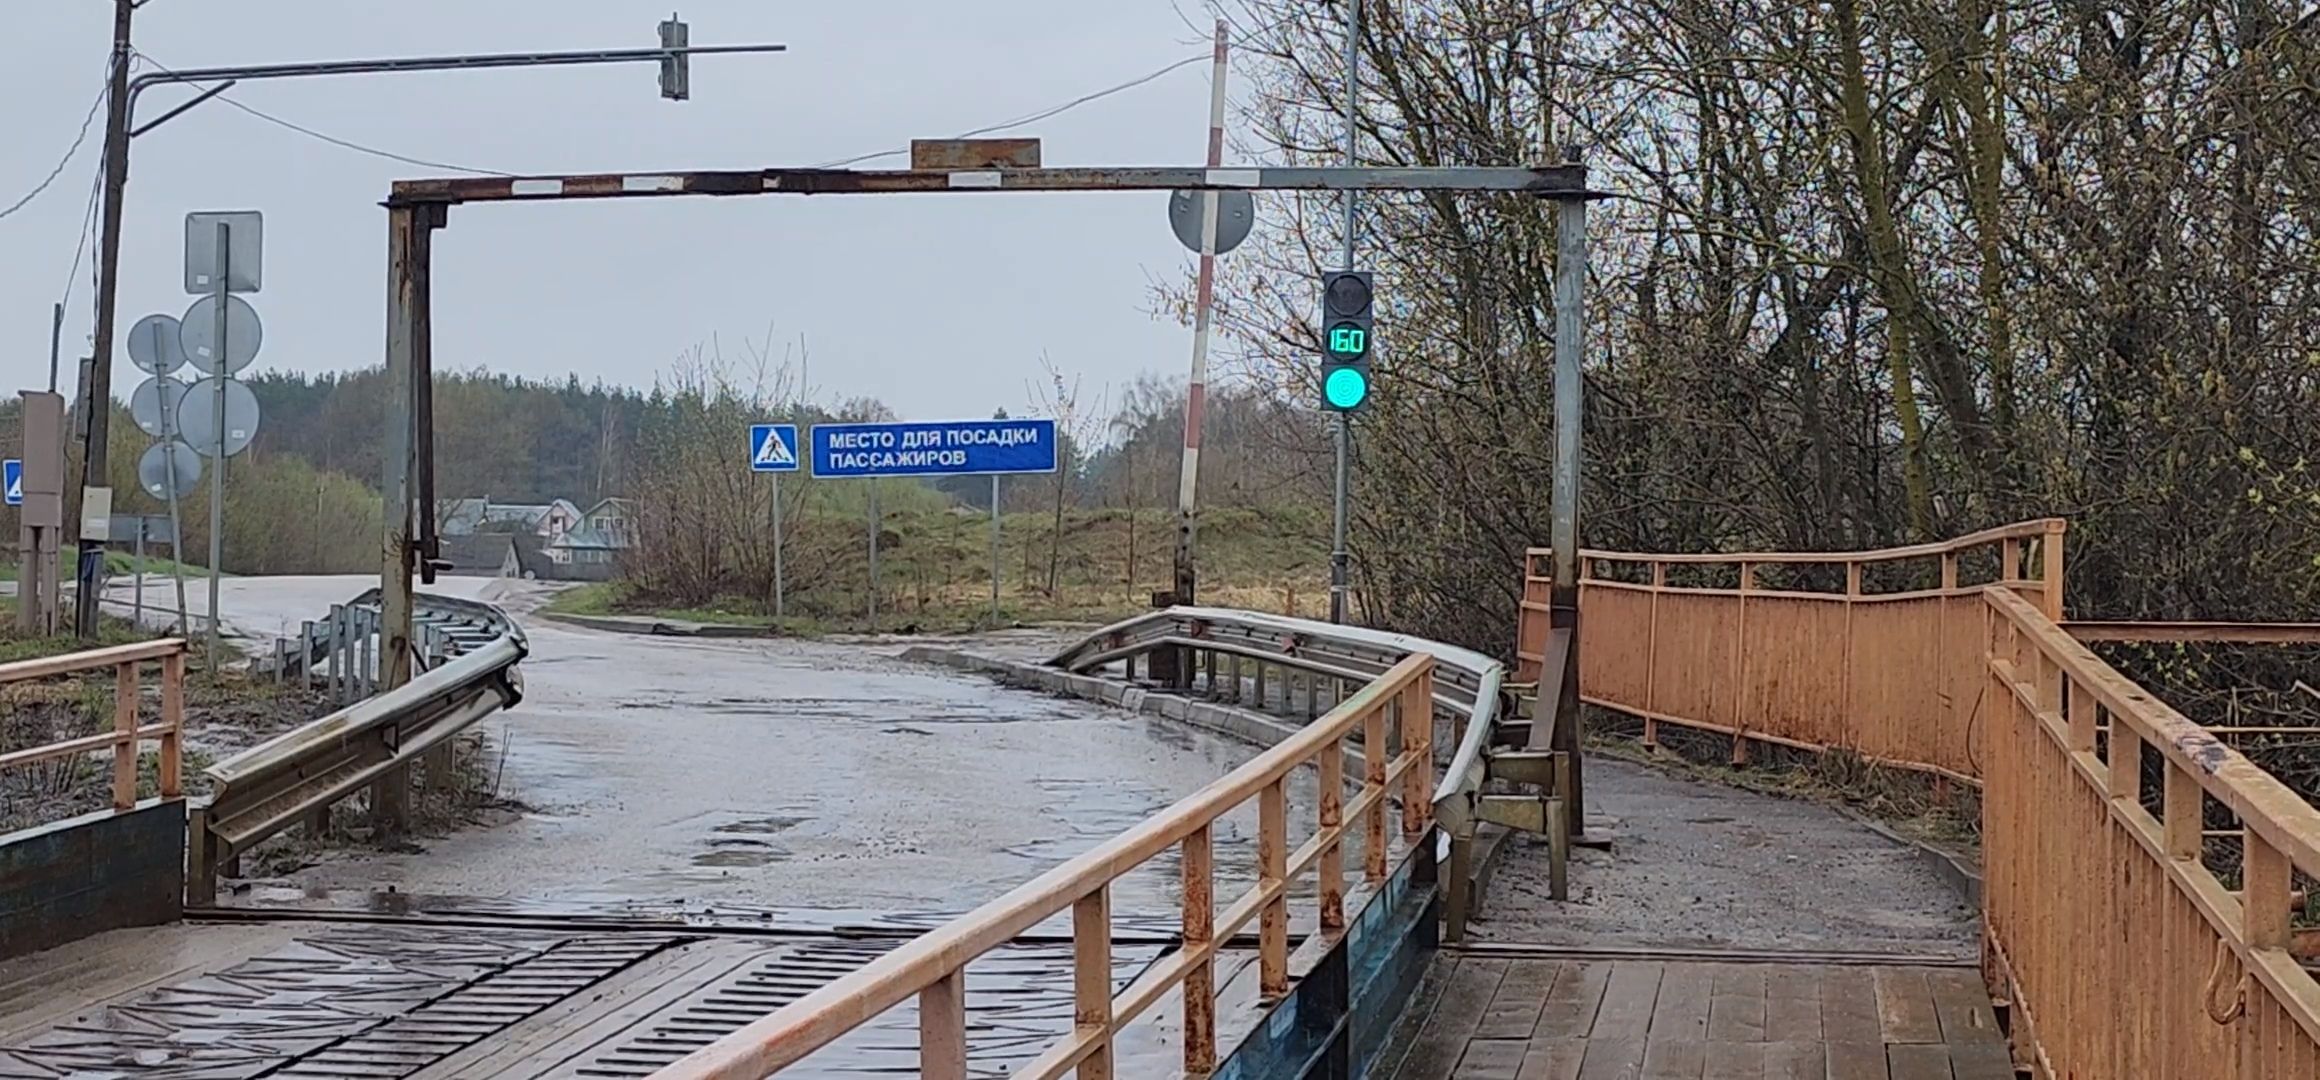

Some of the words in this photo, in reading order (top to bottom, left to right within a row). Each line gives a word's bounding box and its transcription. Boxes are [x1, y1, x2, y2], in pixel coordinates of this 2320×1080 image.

[1331, 330, 1364, 352] 160
[829, 432, 895, 449] МЕСТО
[902, 430, 941, 447] ДЛЯ
[946, 428, 1038, 446] ПОСАДКИ
[830, 450, 967, 468] ПАССАЖИРОВ
